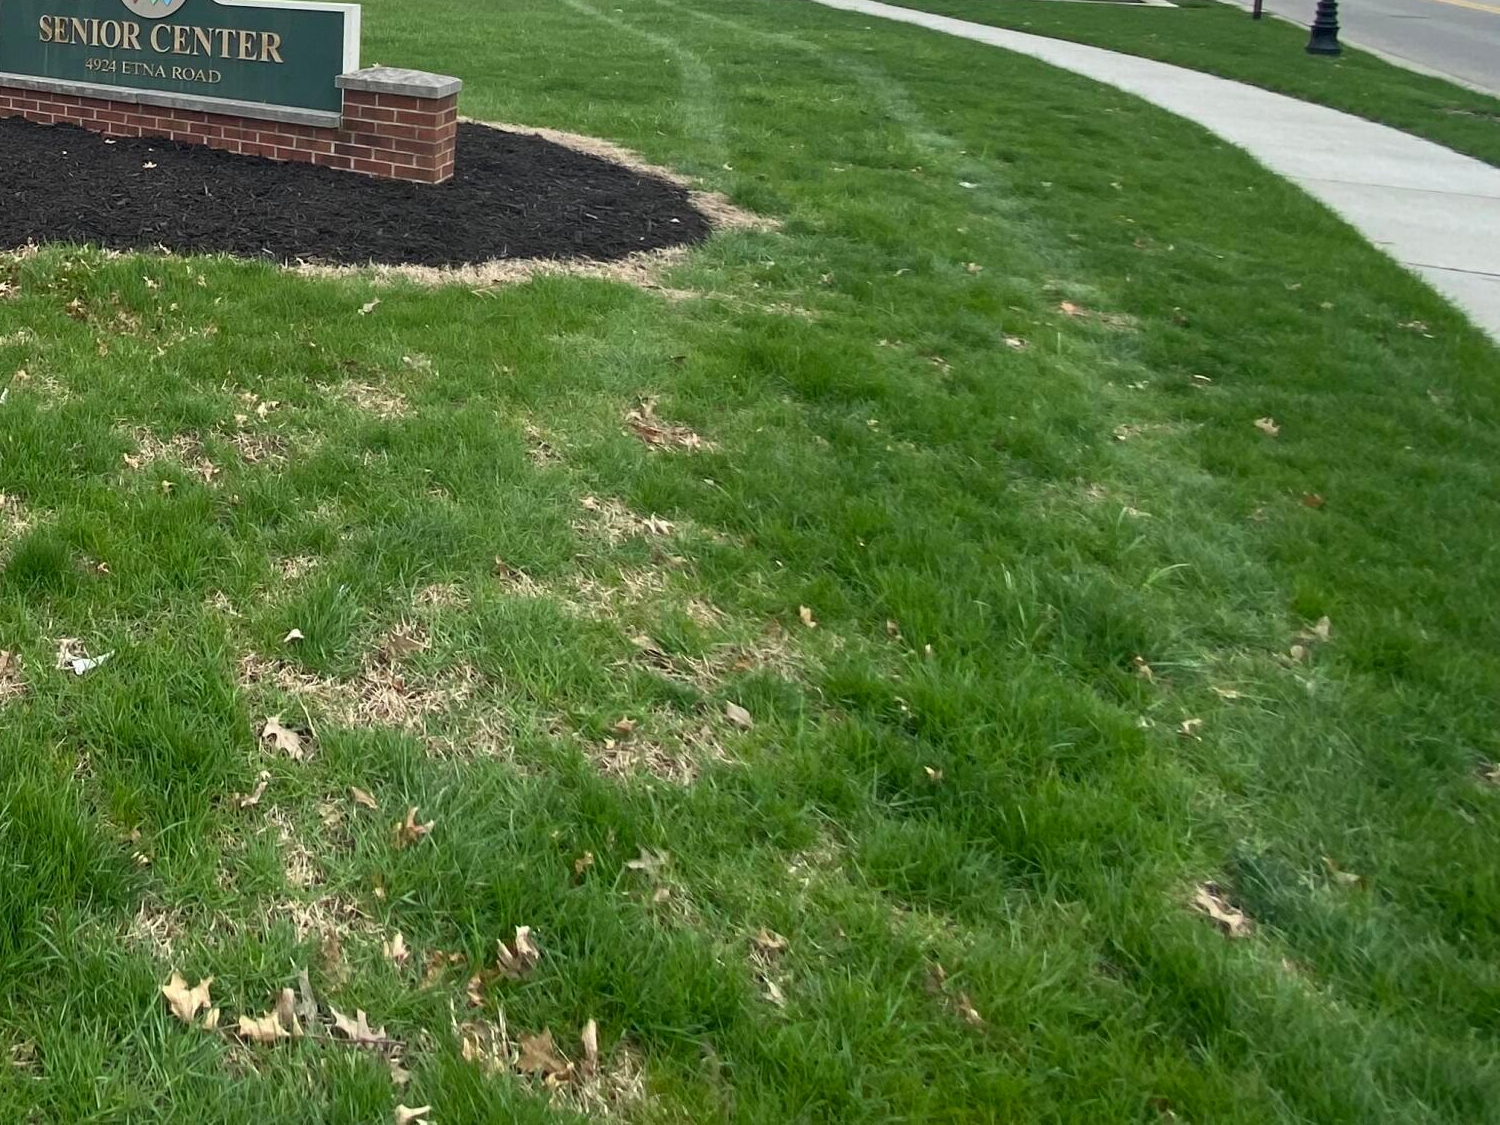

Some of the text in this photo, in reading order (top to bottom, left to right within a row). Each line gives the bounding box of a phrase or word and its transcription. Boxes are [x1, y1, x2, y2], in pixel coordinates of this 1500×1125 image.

[38, 14, 284, 64] SENIOR CENTER
[85, 57, 221, 84] 4924 ETNA ROAD
